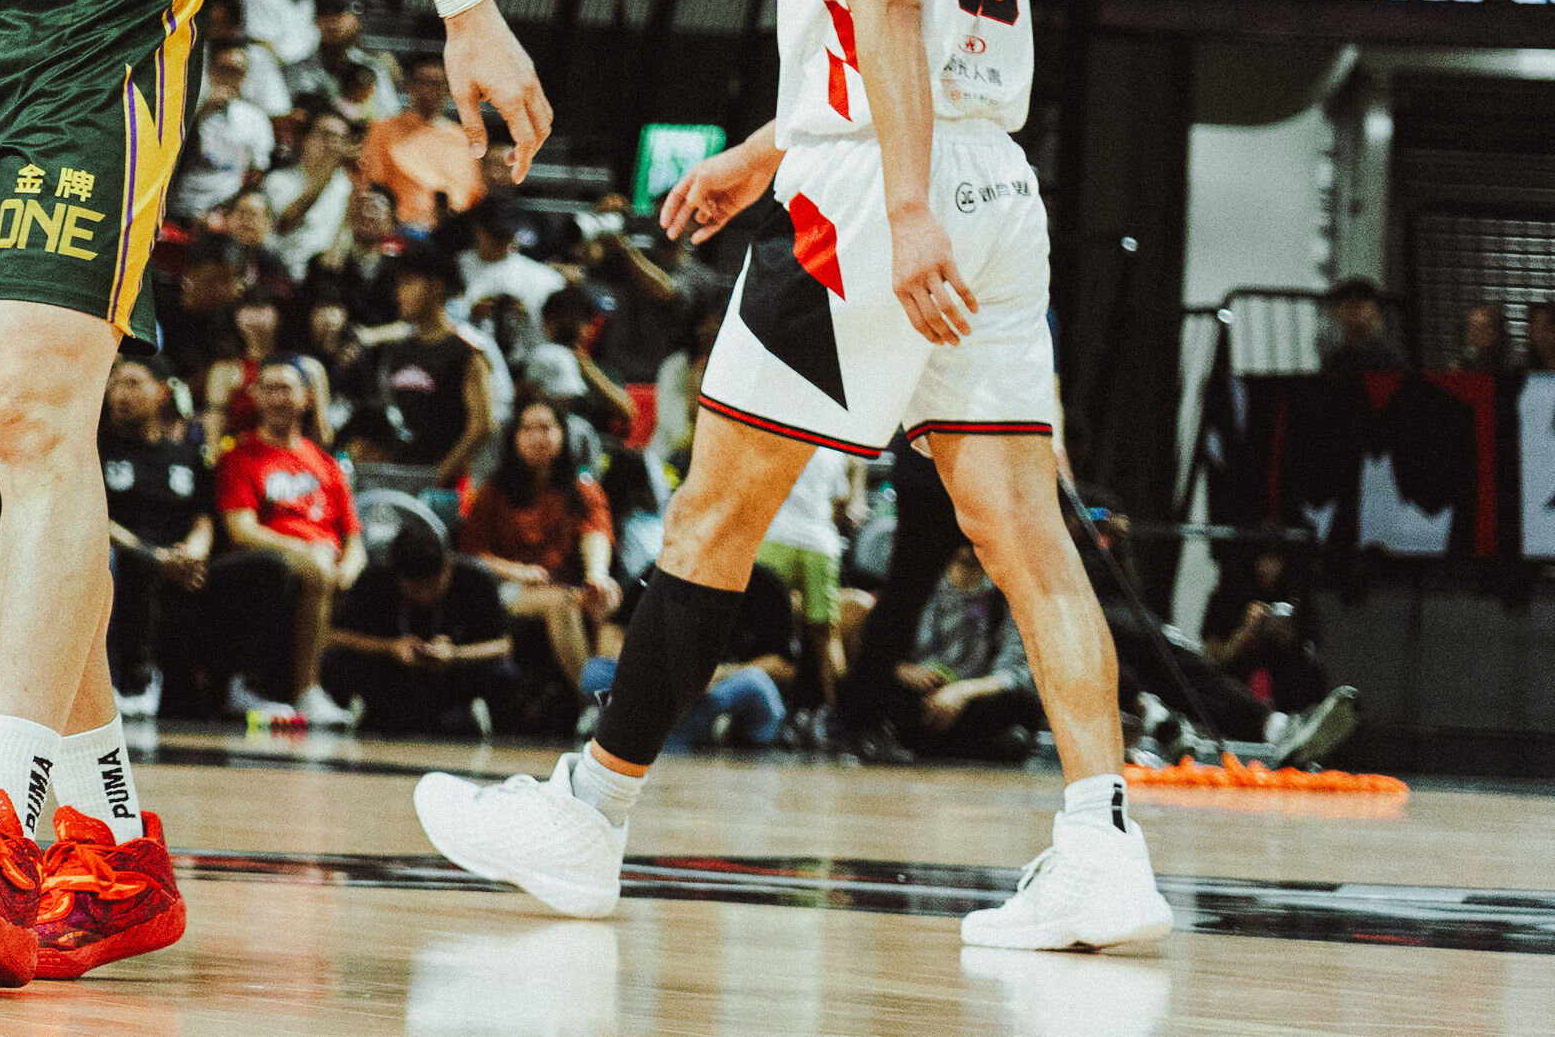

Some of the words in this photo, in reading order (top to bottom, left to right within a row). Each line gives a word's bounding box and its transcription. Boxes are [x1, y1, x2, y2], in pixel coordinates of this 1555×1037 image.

[14, 163, 96, 202] 金牌
[25, 755, 54, 833] PUMA
[98, 748, 136, 820] PUMA
